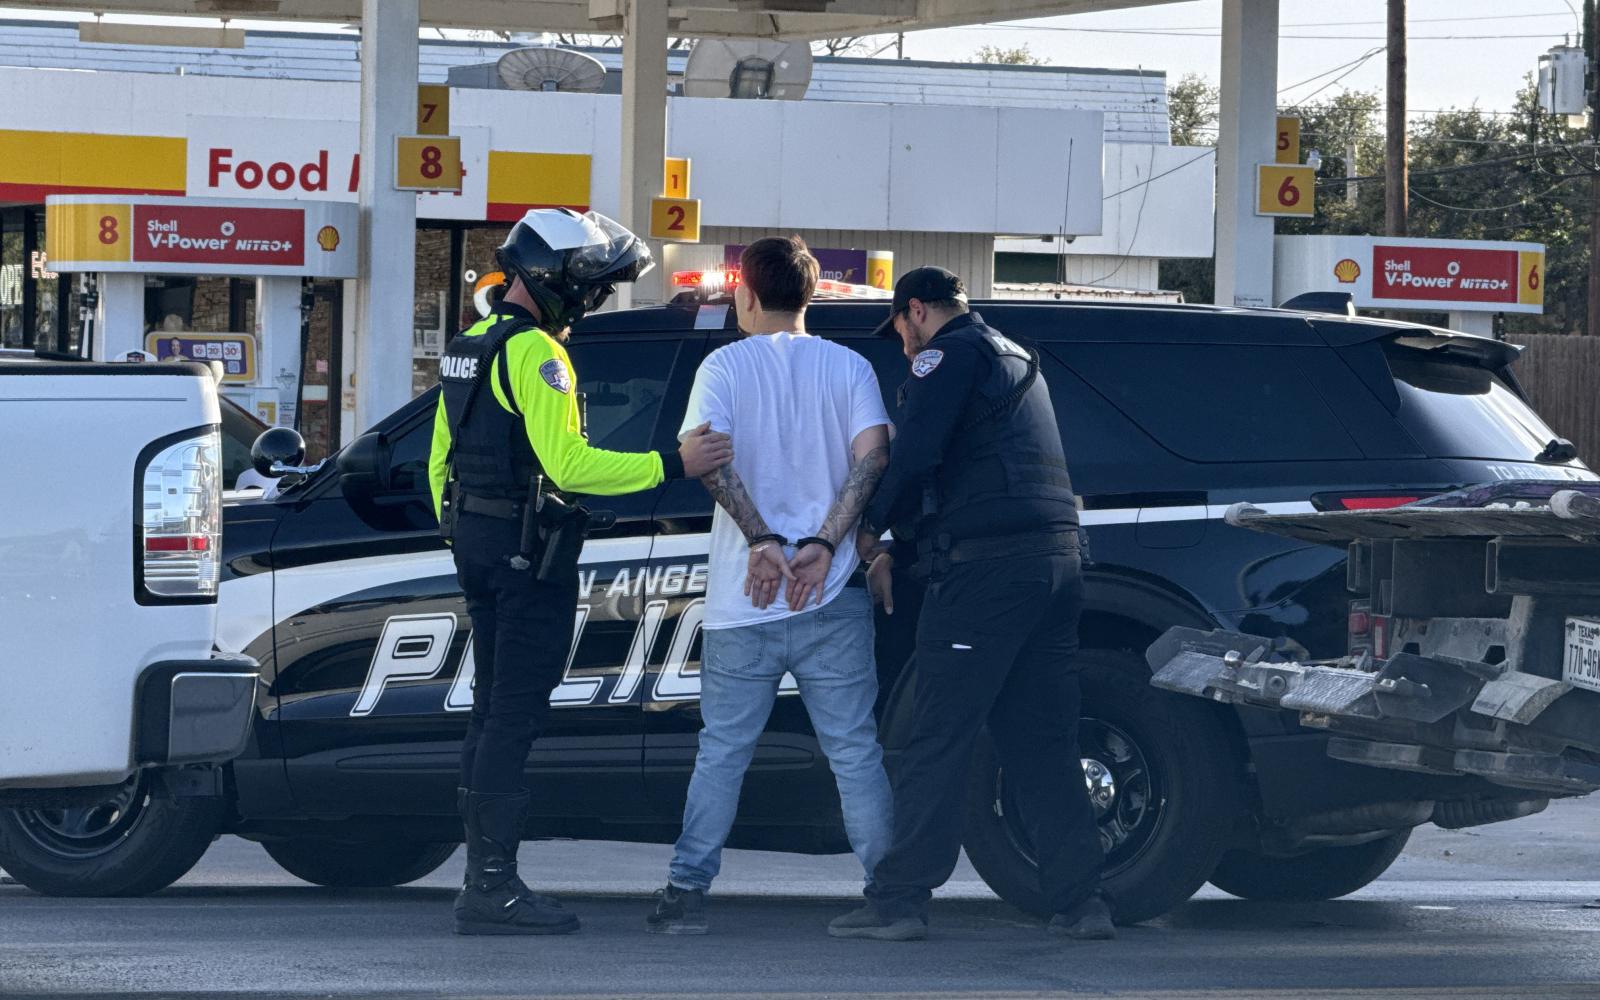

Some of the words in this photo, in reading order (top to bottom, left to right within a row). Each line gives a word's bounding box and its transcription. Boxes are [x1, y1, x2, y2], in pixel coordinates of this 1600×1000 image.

[422, 104, 437, 123] 7
[1277, 132, 1290, 150] 5
[208, 148, 328, 192] Food
[420, 146, 443, 179] 8
[672, 174, 678, 189] 1
[1278, 176, 1300, 207] 6
[98, 215, 119, 244] 8
[147, 219, 178, 232] Shell
[667, 206, 685, 231] 2
[147, 232, 229, 250] V-Power
[1384, 260, 1411, 272] Shell
[1528, 264, 1539, 290] 6
[0, 264, 24, 305] OPE
[876, 268, 885, 289] 2
[1385, 272, 1454, 288] V-Power
[606, 563, 709, 598] ANGE
[1578, 624, 1594, 640] TEXAS
[349, 597, 800, 717] PLIC
